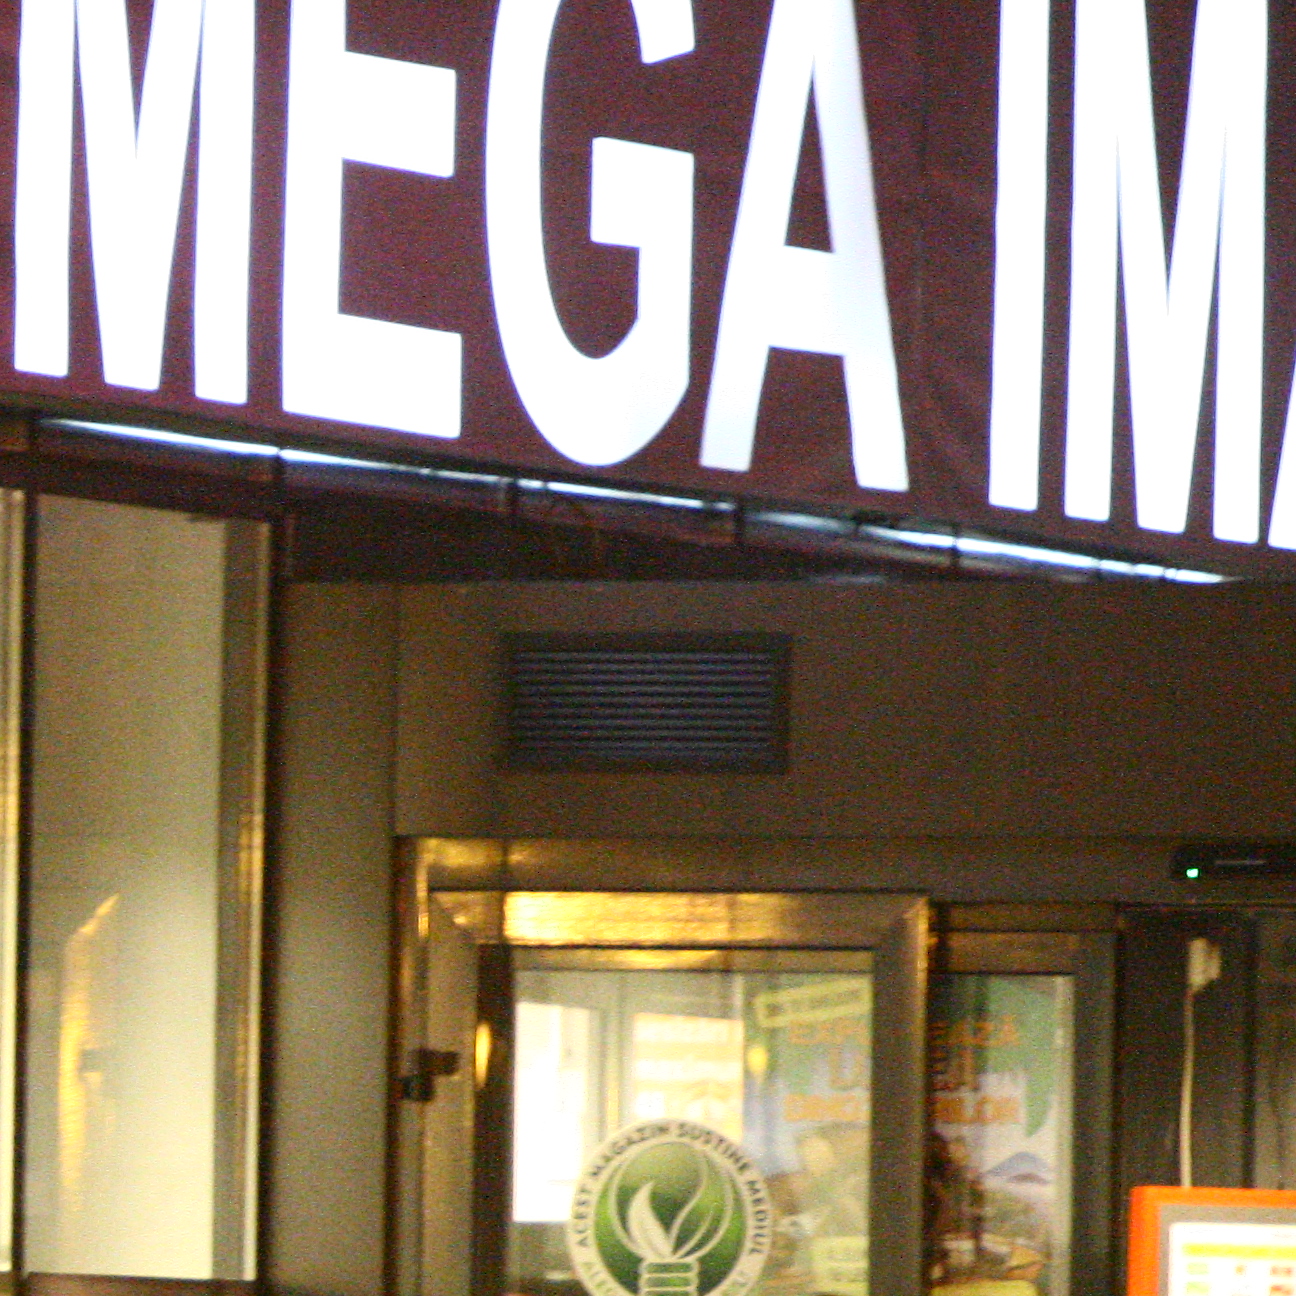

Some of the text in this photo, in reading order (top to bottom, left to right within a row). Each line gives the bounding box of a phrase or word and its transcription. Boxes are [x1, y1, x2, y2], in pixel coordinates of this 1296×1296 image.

[14, 0, 1296, 548] MEGA IM
[589, 1121, 670, 1177] MAGAZIN
[746, 1178, 770, 1256] MEDIUL
